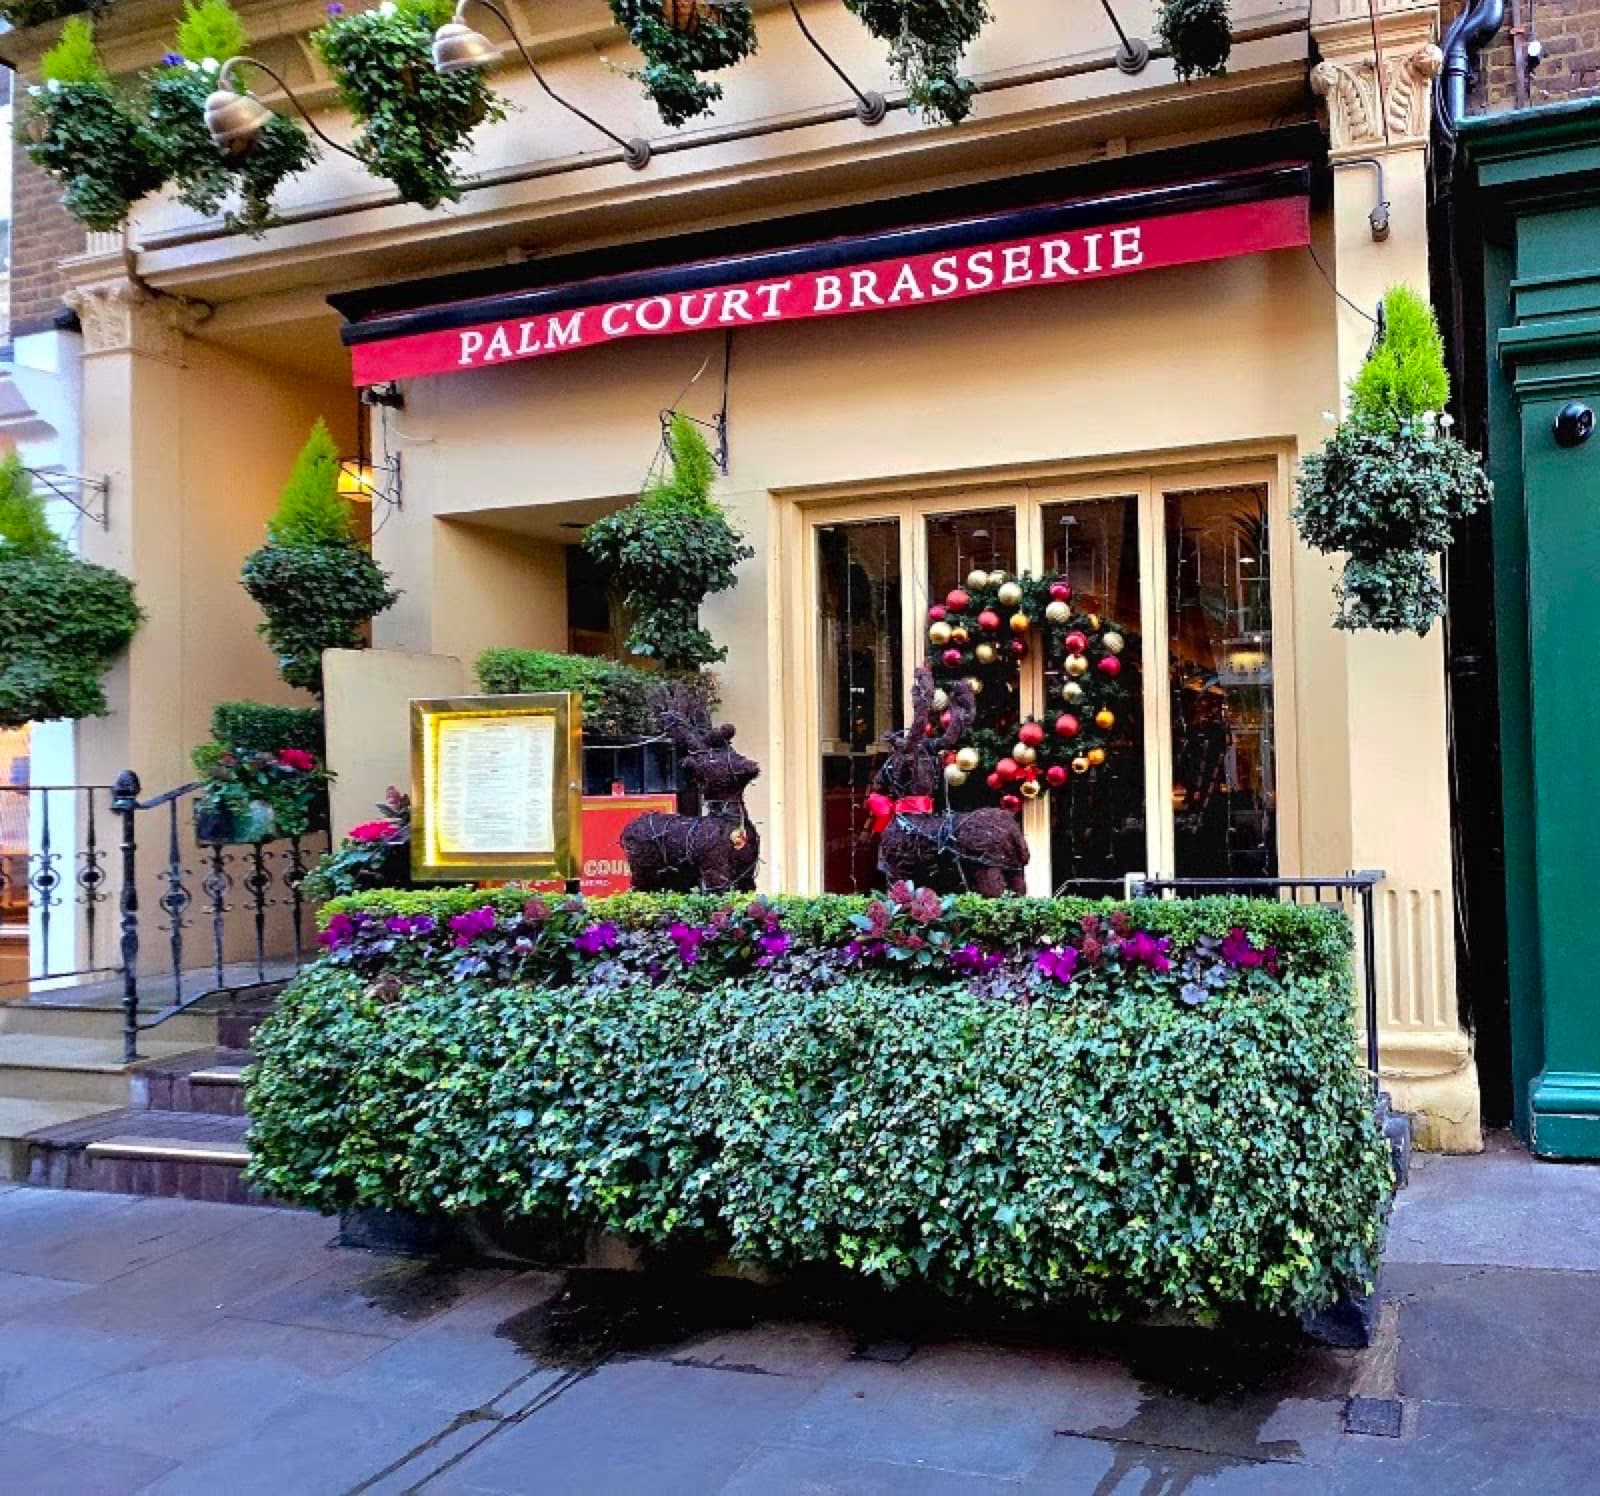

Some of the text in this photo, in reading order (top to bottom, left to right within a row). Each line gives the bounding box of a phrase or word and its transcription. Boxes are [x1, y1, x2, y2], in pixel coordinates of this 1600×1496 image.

[457, 226, 1144, 365] PALM COURT BRASSERIE
